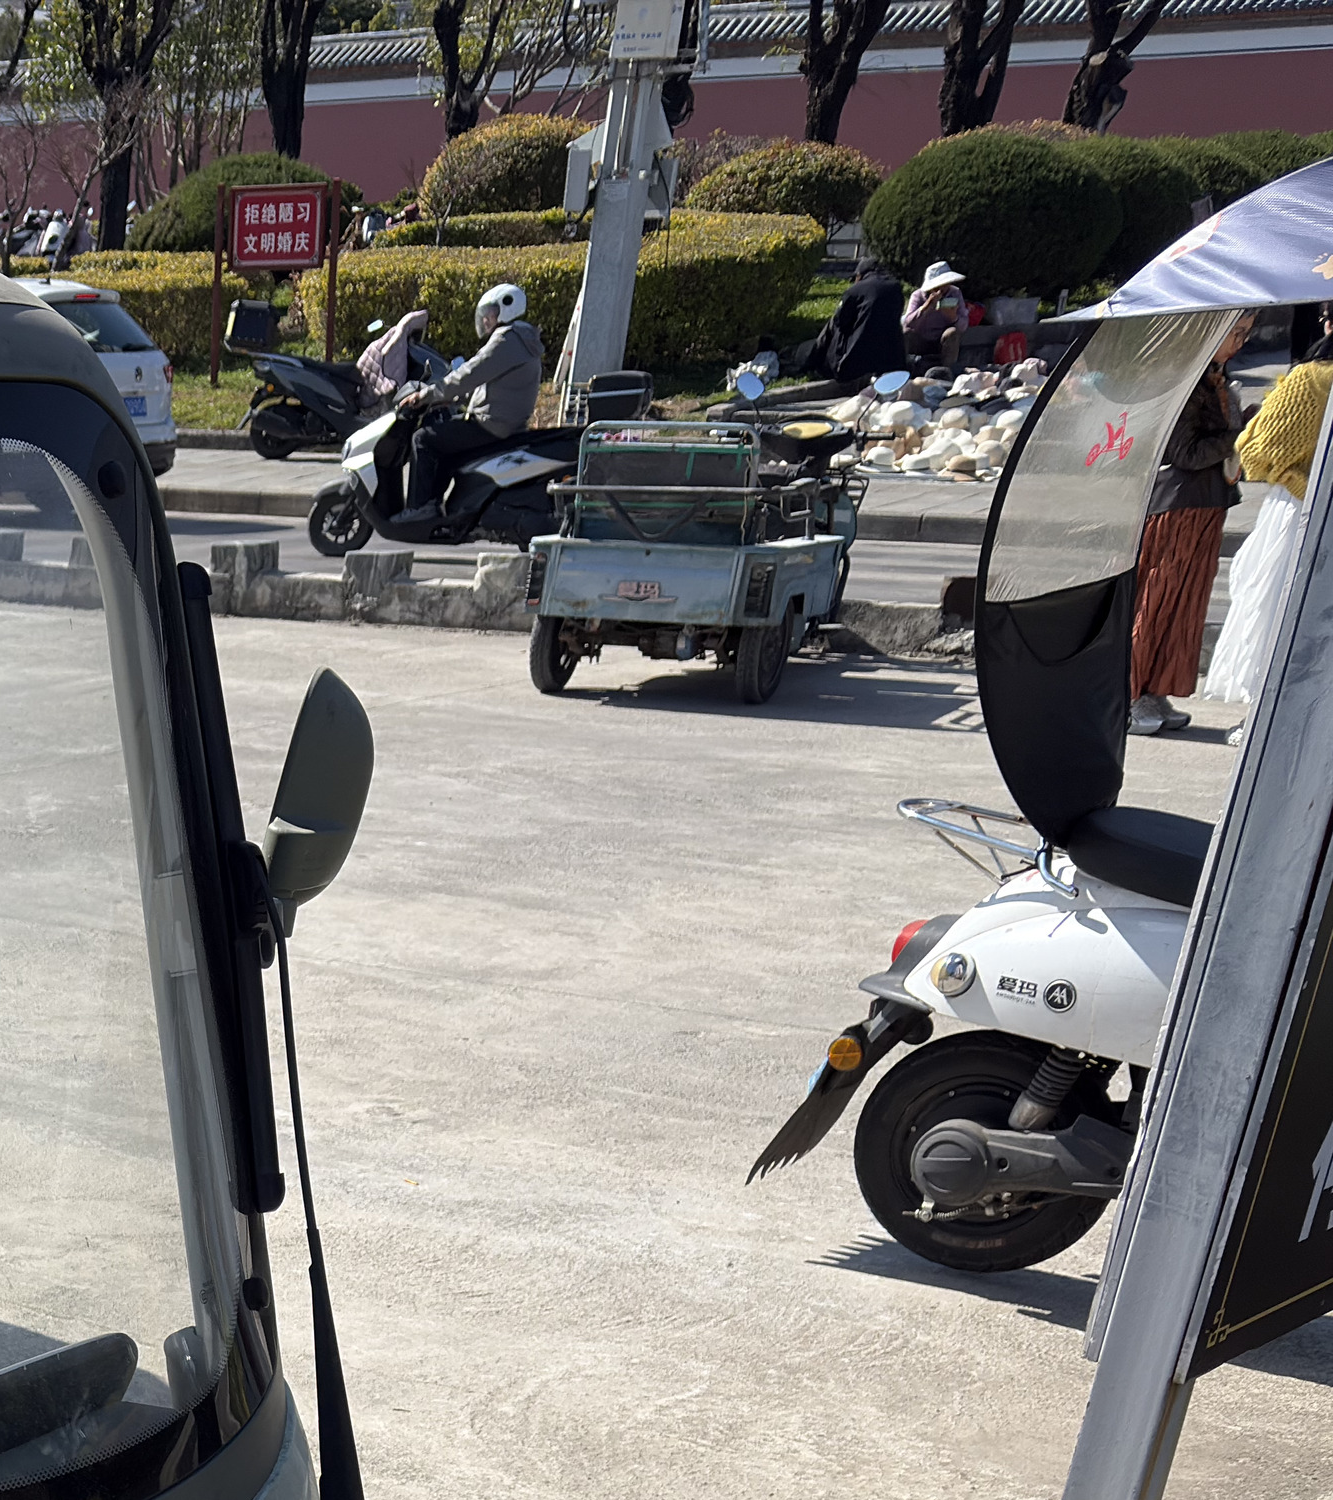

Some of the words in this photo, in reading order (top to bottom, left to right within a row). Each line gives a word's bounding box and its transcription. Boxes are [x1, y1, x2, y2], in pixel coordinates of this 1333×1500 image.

[244, 203, 310, 225] 拒绝陋习
[244, 232, 310, 254] 文明婚庆
[997, 975, 1038, 998] 爱玛
